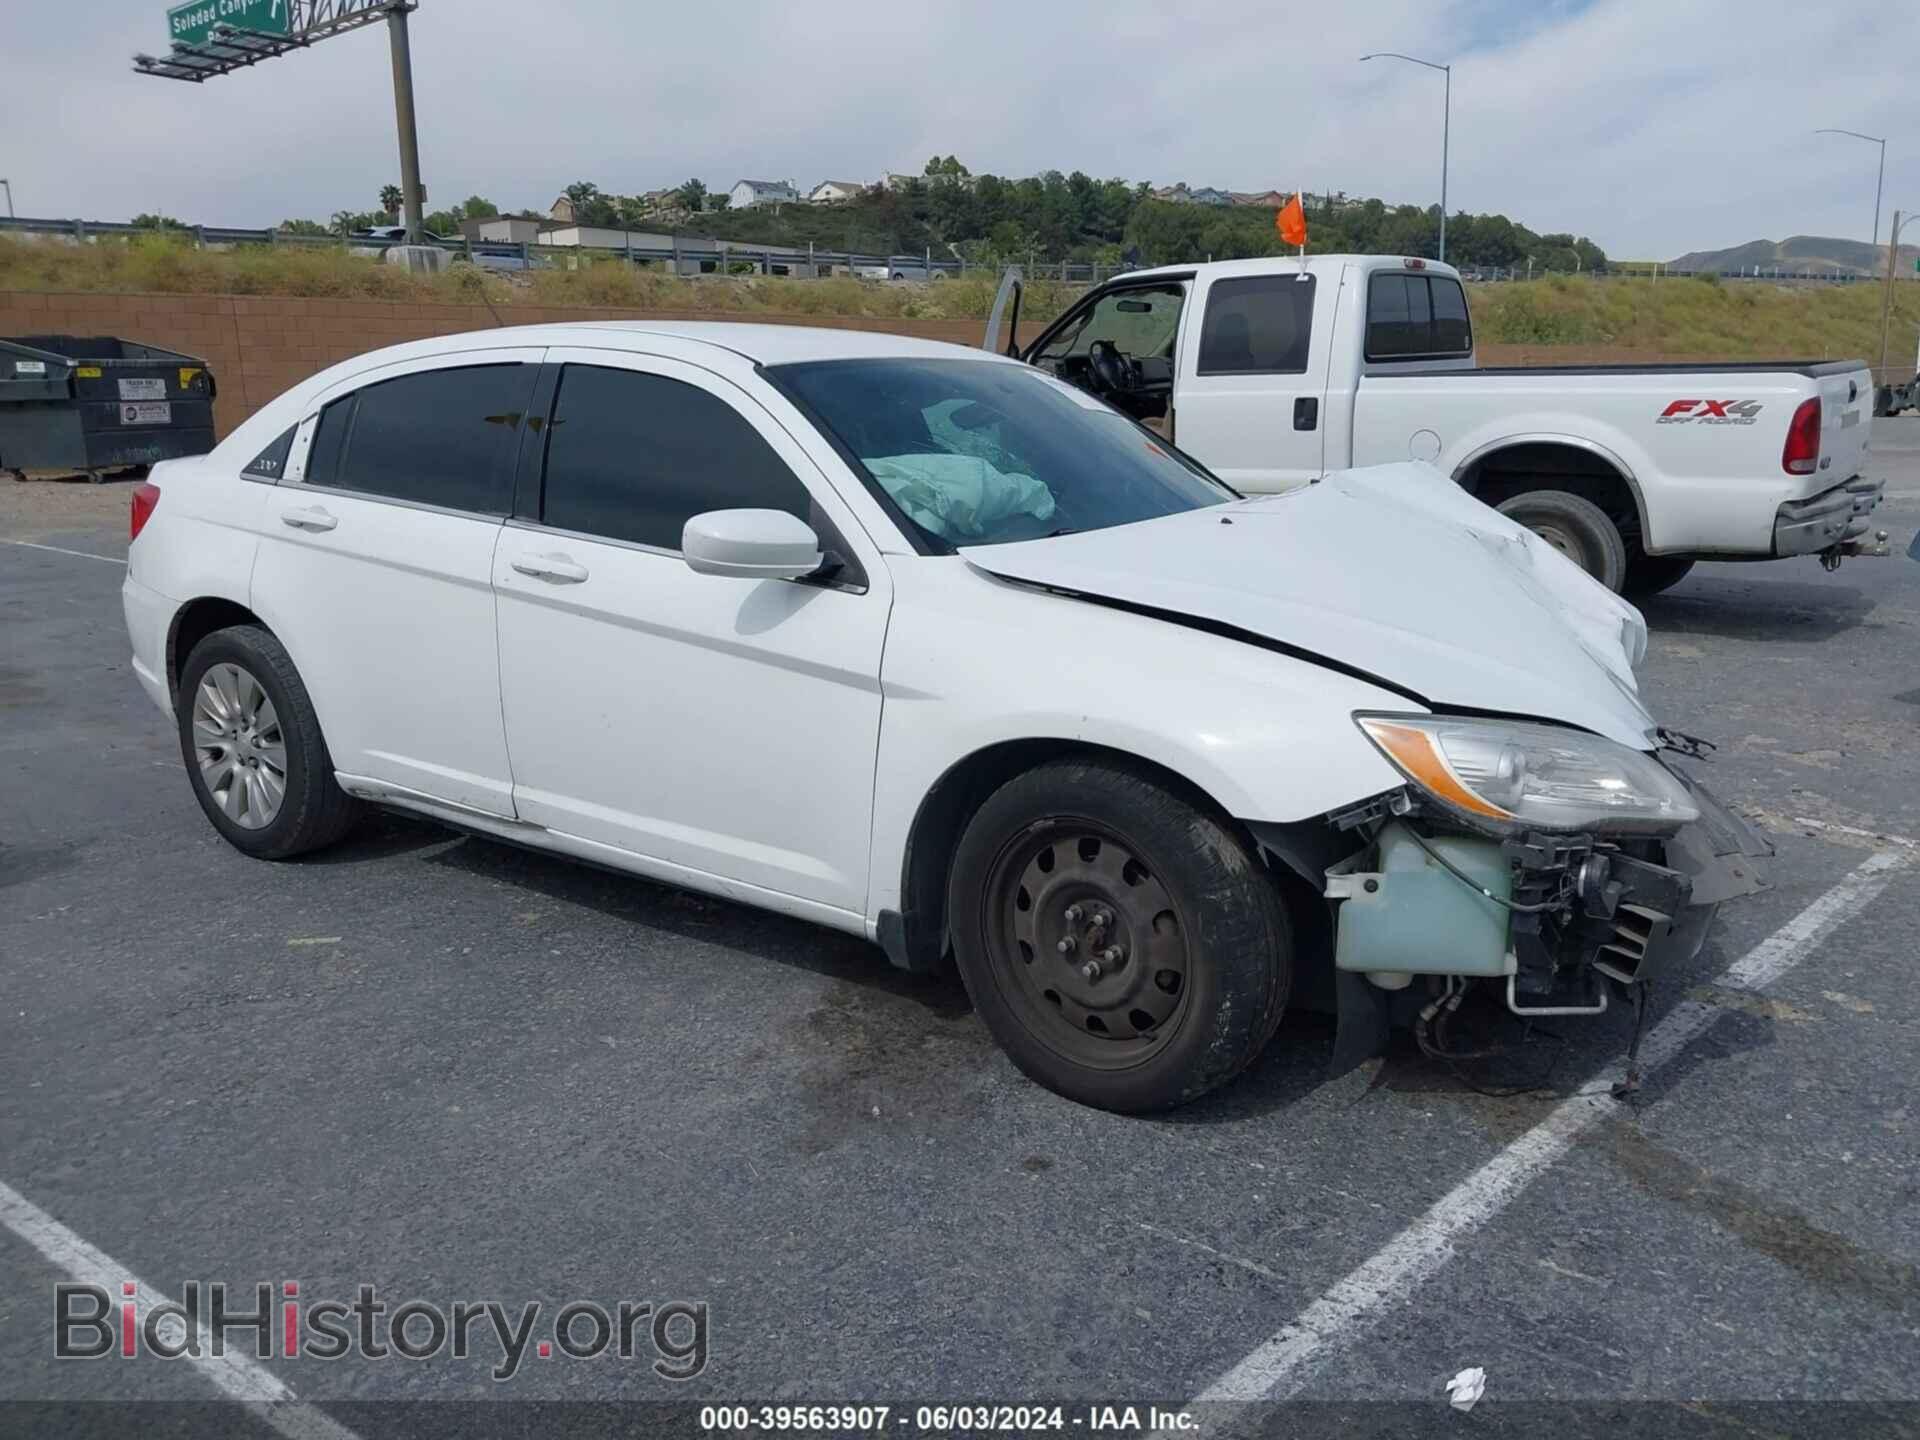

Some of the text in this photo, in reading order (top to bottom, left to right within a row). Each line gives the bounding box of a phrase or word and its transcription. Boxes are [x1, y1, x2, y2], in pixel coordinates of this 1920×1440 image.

[173, 0, 262, 33] Soledad Canyo
[1660, 399, 1763, 417] FX4
[1697, 417, 1757, 425] ROAD
